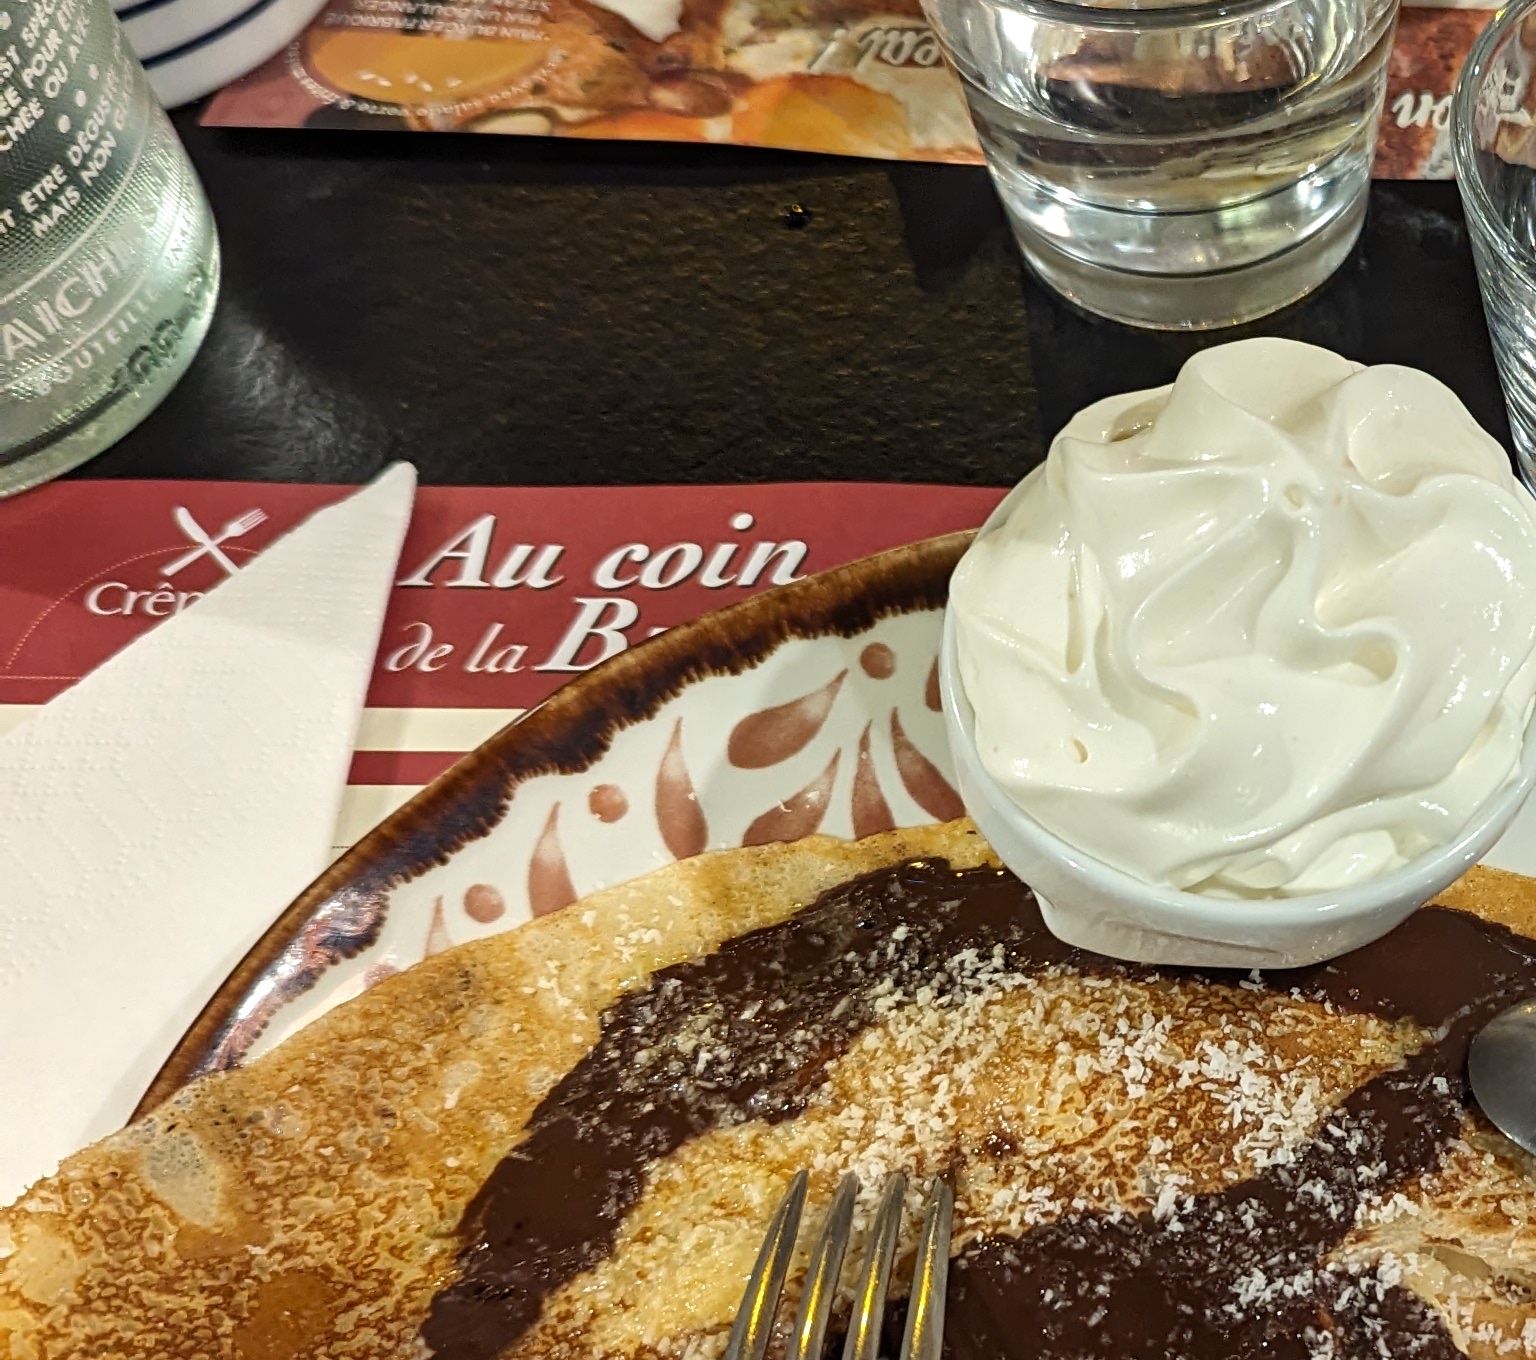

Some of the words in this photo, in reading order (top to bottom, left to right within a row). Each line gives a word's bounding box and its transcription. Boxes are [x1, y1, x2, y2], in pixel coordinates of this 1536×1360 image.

[32, 185, 80, 238] MAIS
[81, 131, 118, 186] NON
[397, 512, 565, 590] Au
[594, 512, 808, 589] coin
[387, 623, 454, 673] de
[464, 624, 528, 673] la
